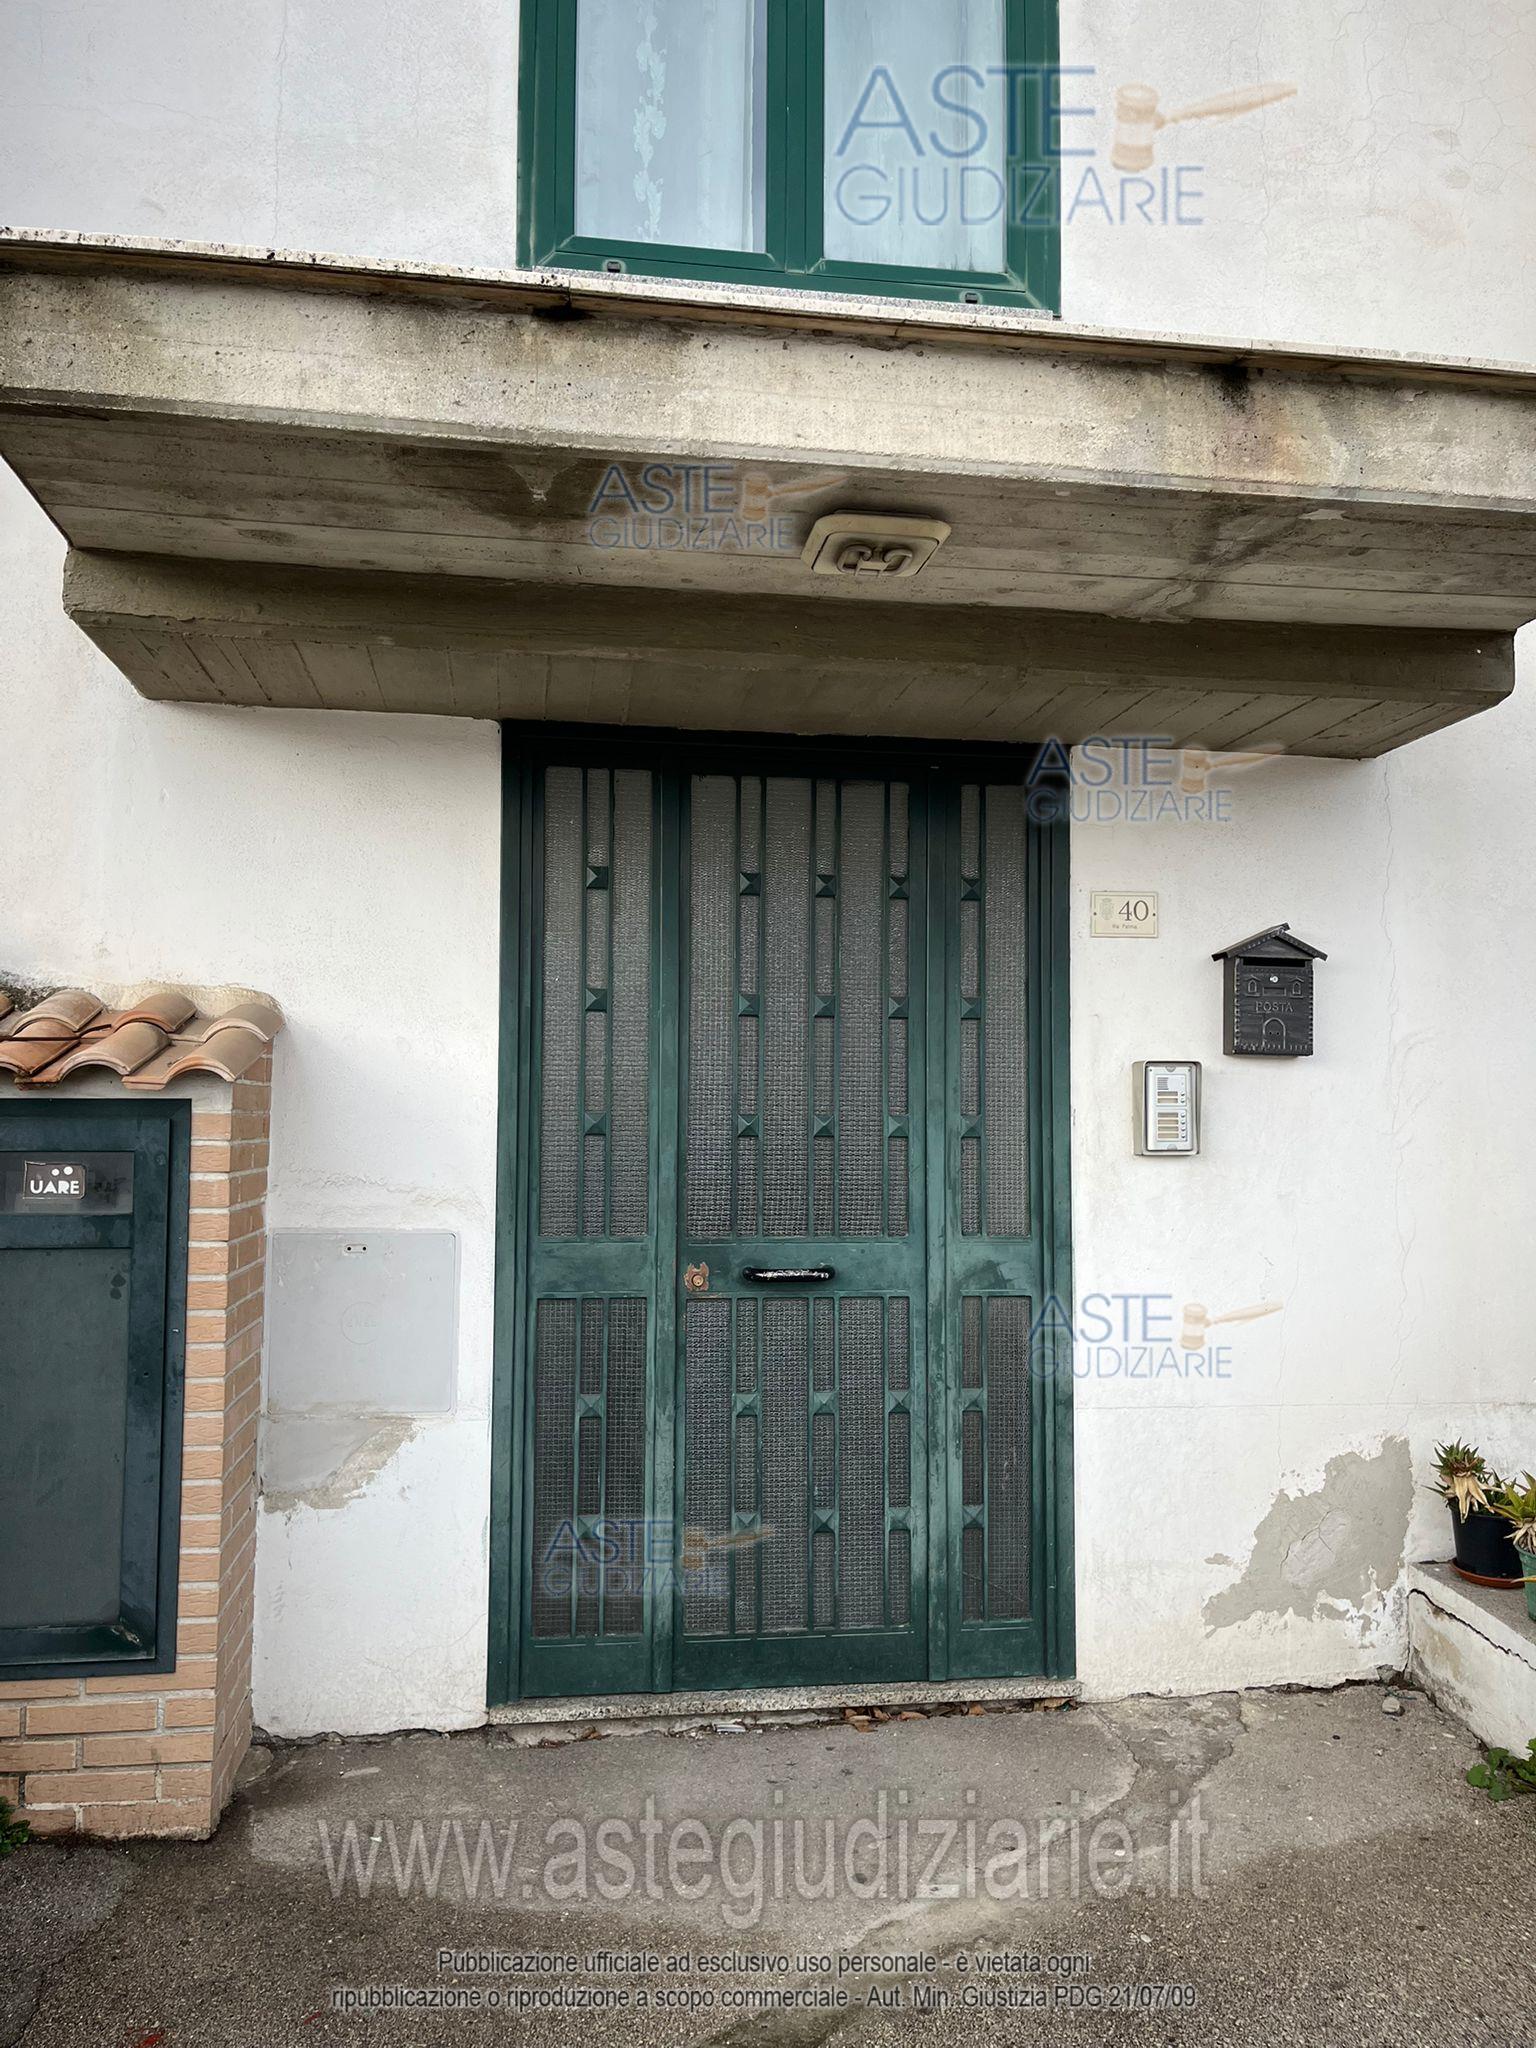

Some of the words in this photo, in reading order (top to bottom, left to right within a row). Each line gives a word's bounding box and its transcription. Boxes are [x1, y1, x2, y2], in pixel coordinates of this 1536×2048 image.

[1118, 900, 1149, 921] 40
[1255, 1001, 1294, 1014] POSTA
[30, 1179, 80, 1195] UARE
